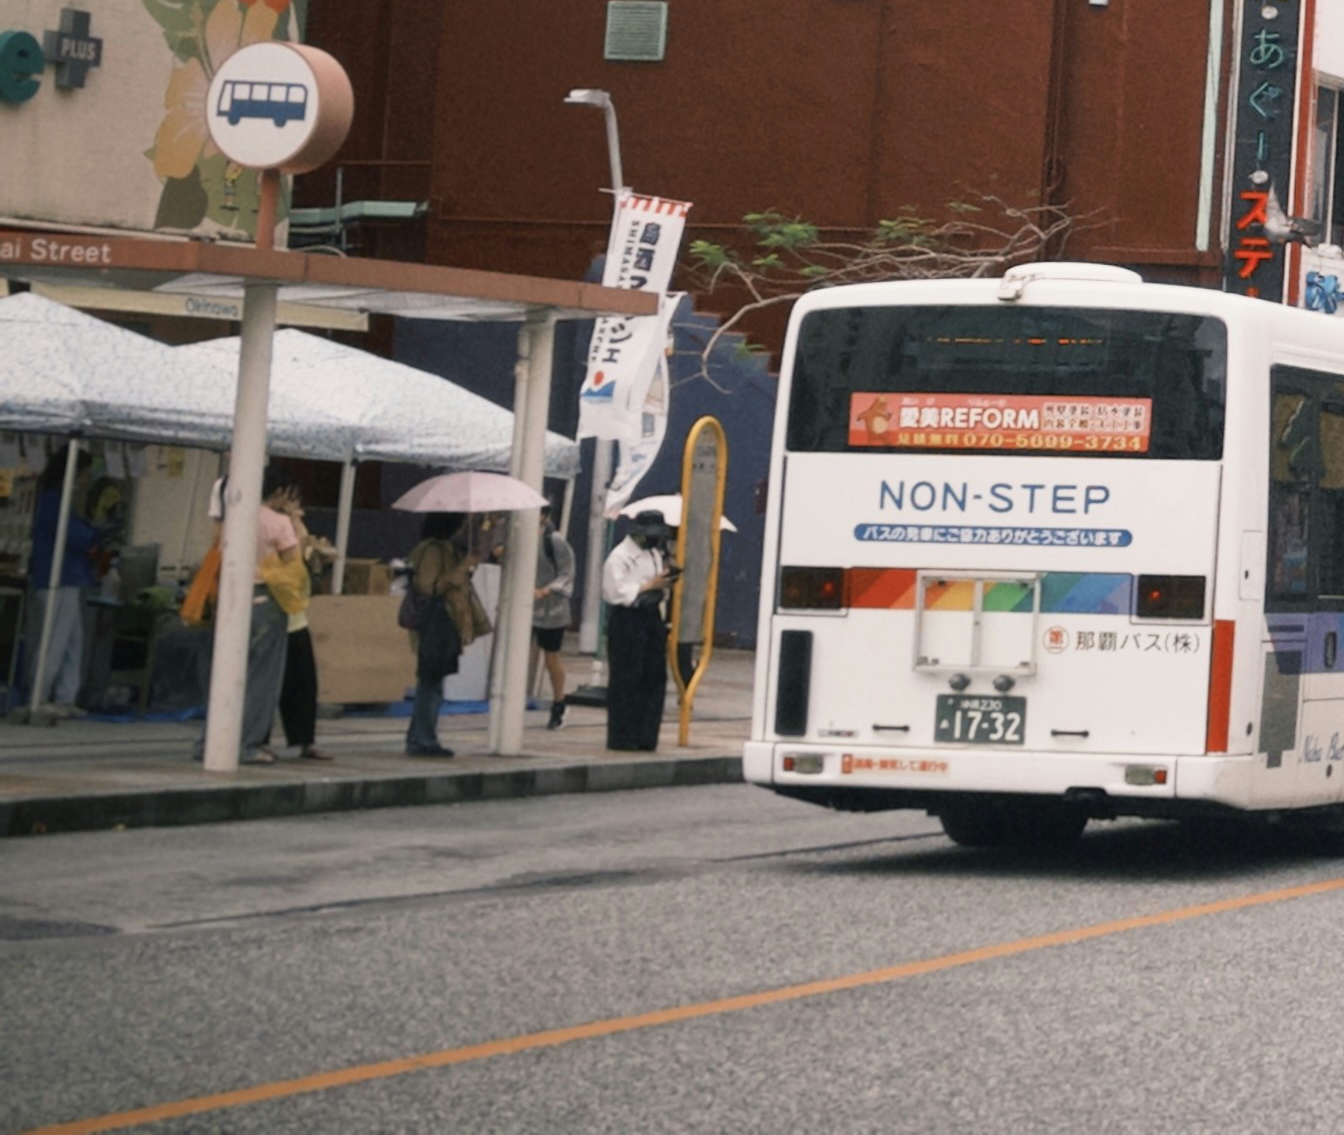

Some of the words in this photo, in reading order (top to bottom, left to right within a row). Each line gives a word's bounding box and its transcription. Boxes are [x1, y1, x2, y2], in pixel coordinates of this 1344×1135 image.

[61, 38, 96, 61] PLUS
[30, 238, 111, 263] Street
[879, 479, 1110, 515] NON-STEP
